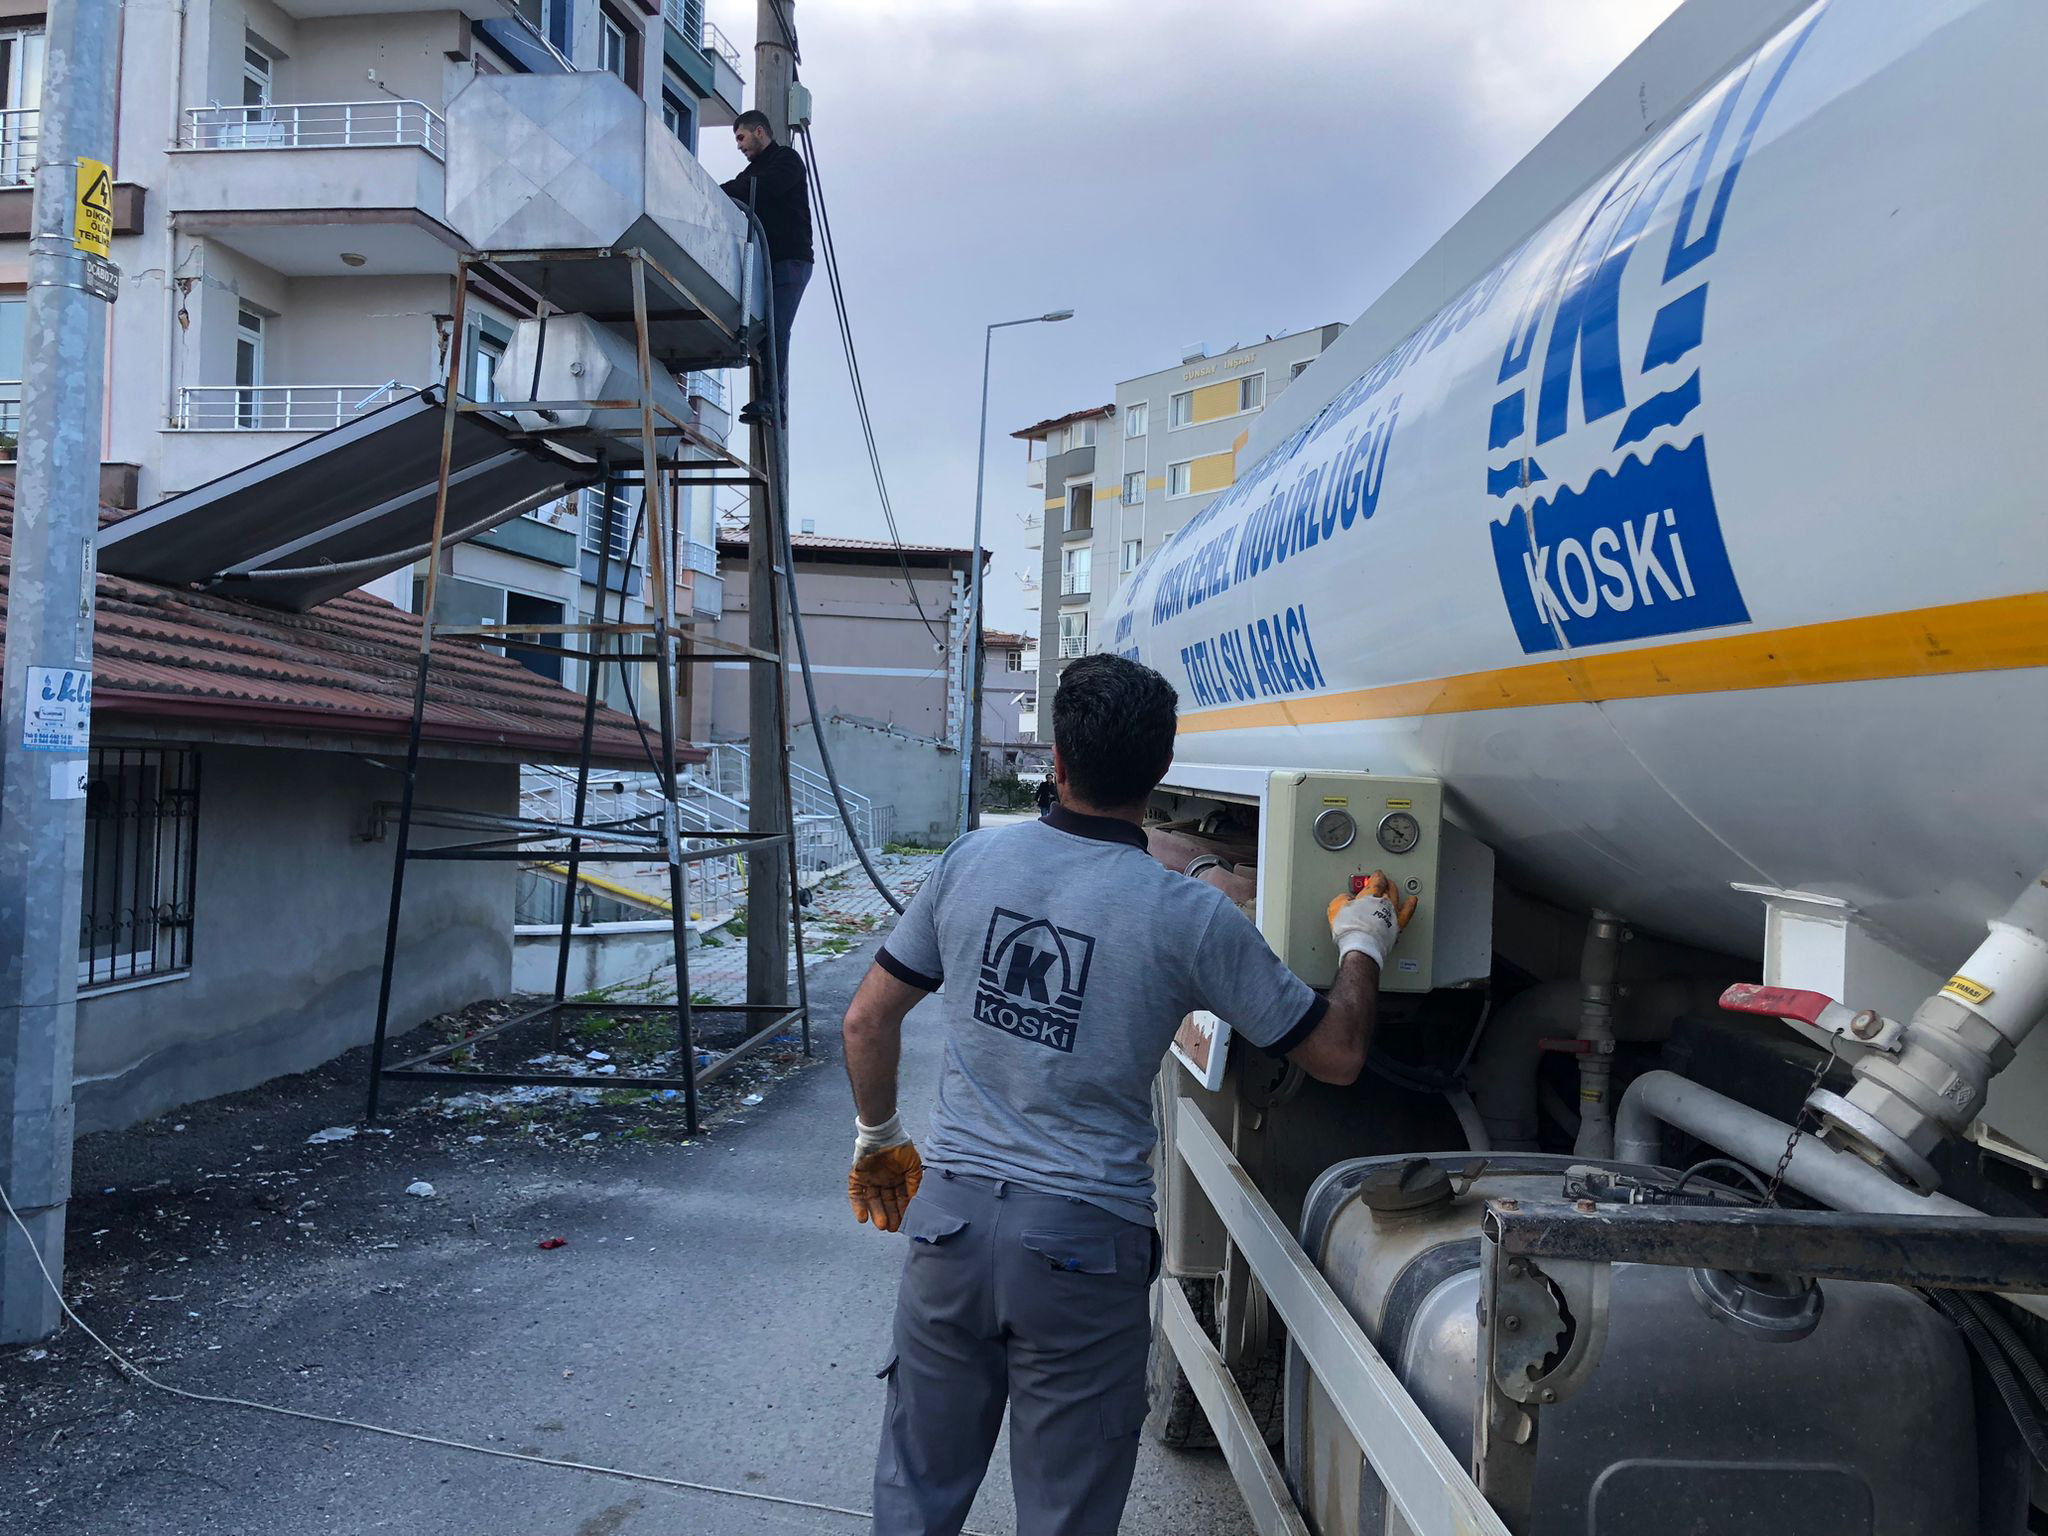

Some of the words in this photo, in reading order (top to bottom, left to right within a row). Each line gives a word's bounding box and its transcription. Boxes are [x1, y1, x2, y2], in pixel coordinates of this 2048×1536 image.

[1188, 523, 1238, 610] GENEL
[1234, 392, 1402, 585] MÜDÜRLÜĞÜ
[1181, 638, 1232, 707] TATLI
[1220, 629, 1256, 701] SU
[1247, 604, 1326, 697] ARACI
